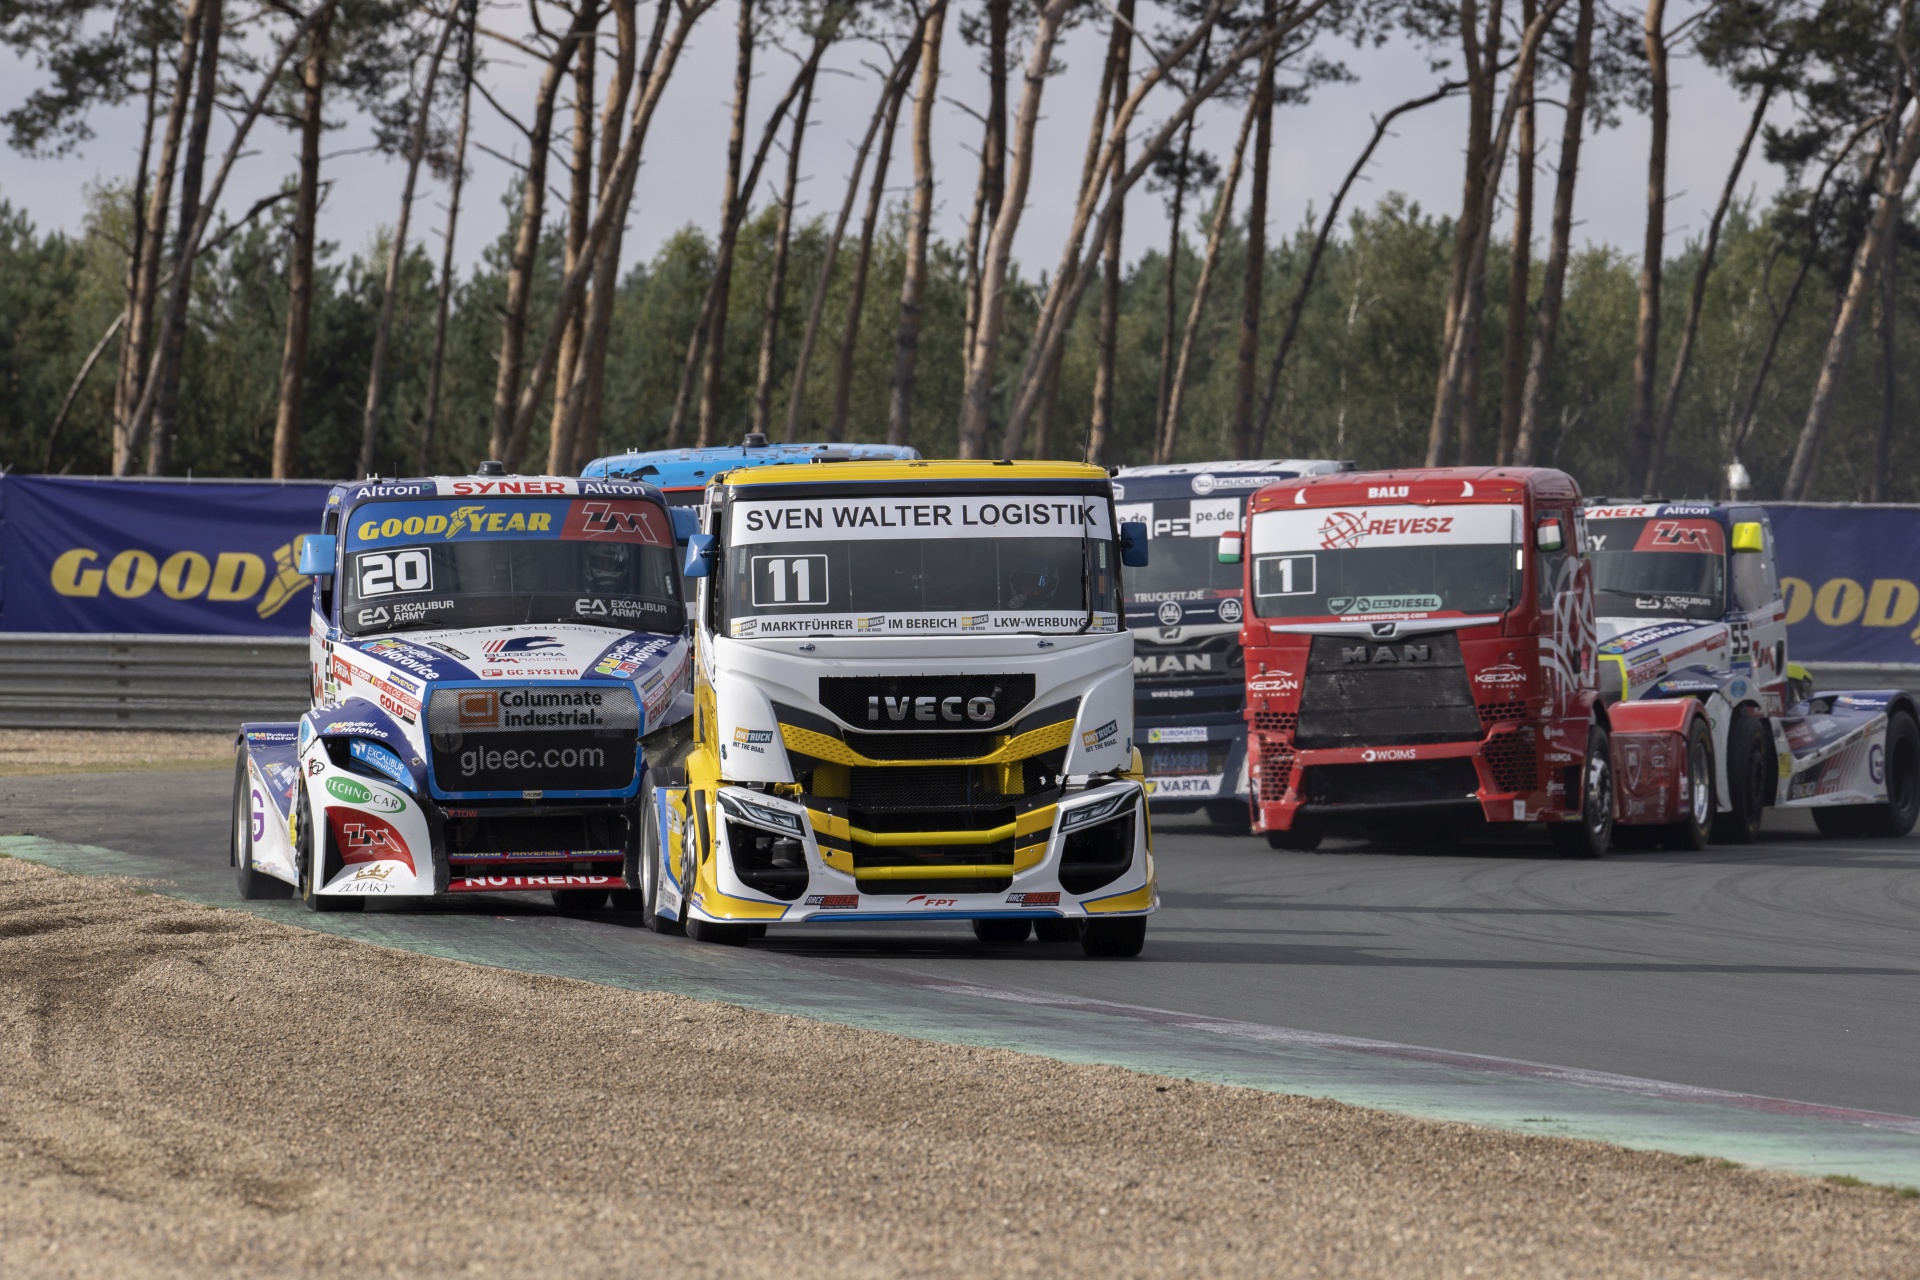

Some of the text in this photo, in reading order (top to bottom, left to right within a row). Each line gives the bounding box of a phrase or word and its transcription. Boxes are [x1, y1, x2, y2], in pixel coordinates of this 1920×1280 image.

[356, 484, 420, 499] Altron
[453, 482, 565, 495] SYNER
[584, 483, 646, 495] Altron
[1368, 486, 1409, 498] BALU
[746, 503, 1097, 531] SVEN WALTER LOGISTIK
[1196, 509, 1234, 523] pe.de
[1664, 506, 1710, 515] Altron
[362, 551, 428, 595] 20
[1279, 559, 1293, 592] 1
[768, 558, 810, 602] 11
[1134, 590, 1204, 603] TRUCKFIT.DE
[1393, 598, 1438, 608] DIESEL
[394, 600, 454, 613] EXCALIBUR
[611, 600, 667, 613] EXCALIBUR
[394, 611, 426, 622] ARMY
[611, 609, 641, 618] ARMY
[962, 614, 988, 626] ONTRUCK
[1340, 612, 1428, 622] www.reveszracing.com
[761, 618, 853, 632] MARKTFÜHRER
[858, 616, 884, 628] ONTRUCK
[888, 618, 957, 628] IM BEREICH
[994, 617, 1087, 628] LKW-WERBUNG
[1731, 623, 1750, 654] 55
[1342, 645, 1429, 664] MAN
[1134, 654, 1211, 674] MAN
[351, 665, 370, 682] ZOLDER
[390, 674, 416, 692] RAVENOL
[380, 694, 403, 716] GOLD
[500, 690, 602, 707] Columnate
[867, 696, 996, 721] IVECO
[735, 730, 772, 742] ONTRUCK
[1085, 721, 1117, 744] ONTRUCK
[367, 747, 404, 773] EXCALIBUR
[461, 745, 604, 776] gleec.com
[1377, 749, 1416, 760] WOIMS
[366, 755, 401, 778] INTERNATIONAL
[1160, 779, 1211, 792] VARTA
[457, 810, 477, 818] TOW
[465, 876, 608, 886] NUTREND
